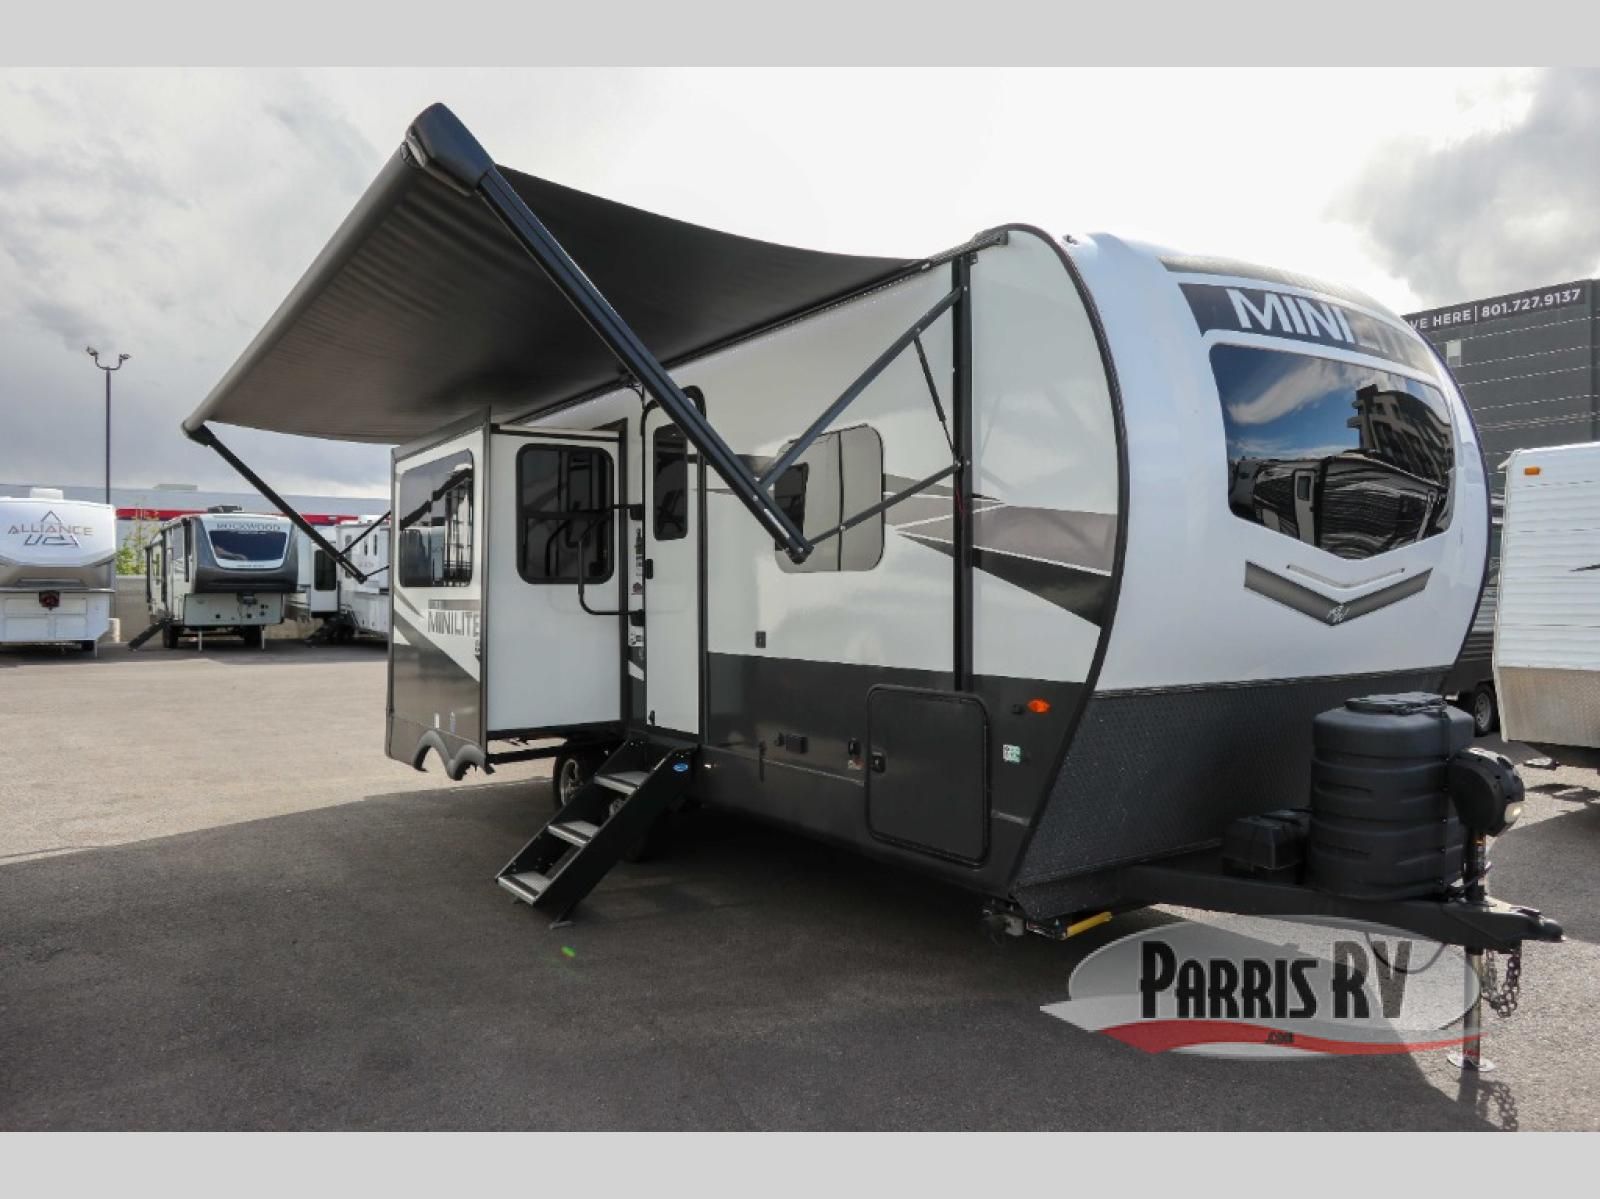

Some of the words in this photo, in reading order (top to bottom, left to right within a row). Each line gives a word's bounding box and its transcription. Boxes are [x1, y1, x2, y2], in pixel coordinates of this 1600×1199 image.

[1432, 309, 1472, 327] HERE
[1482, 288, 1581, 318] 801.727.9137
[7, 523, 94, 536] ALLIANCE
[427, 611, 480, 638] MINILITE
